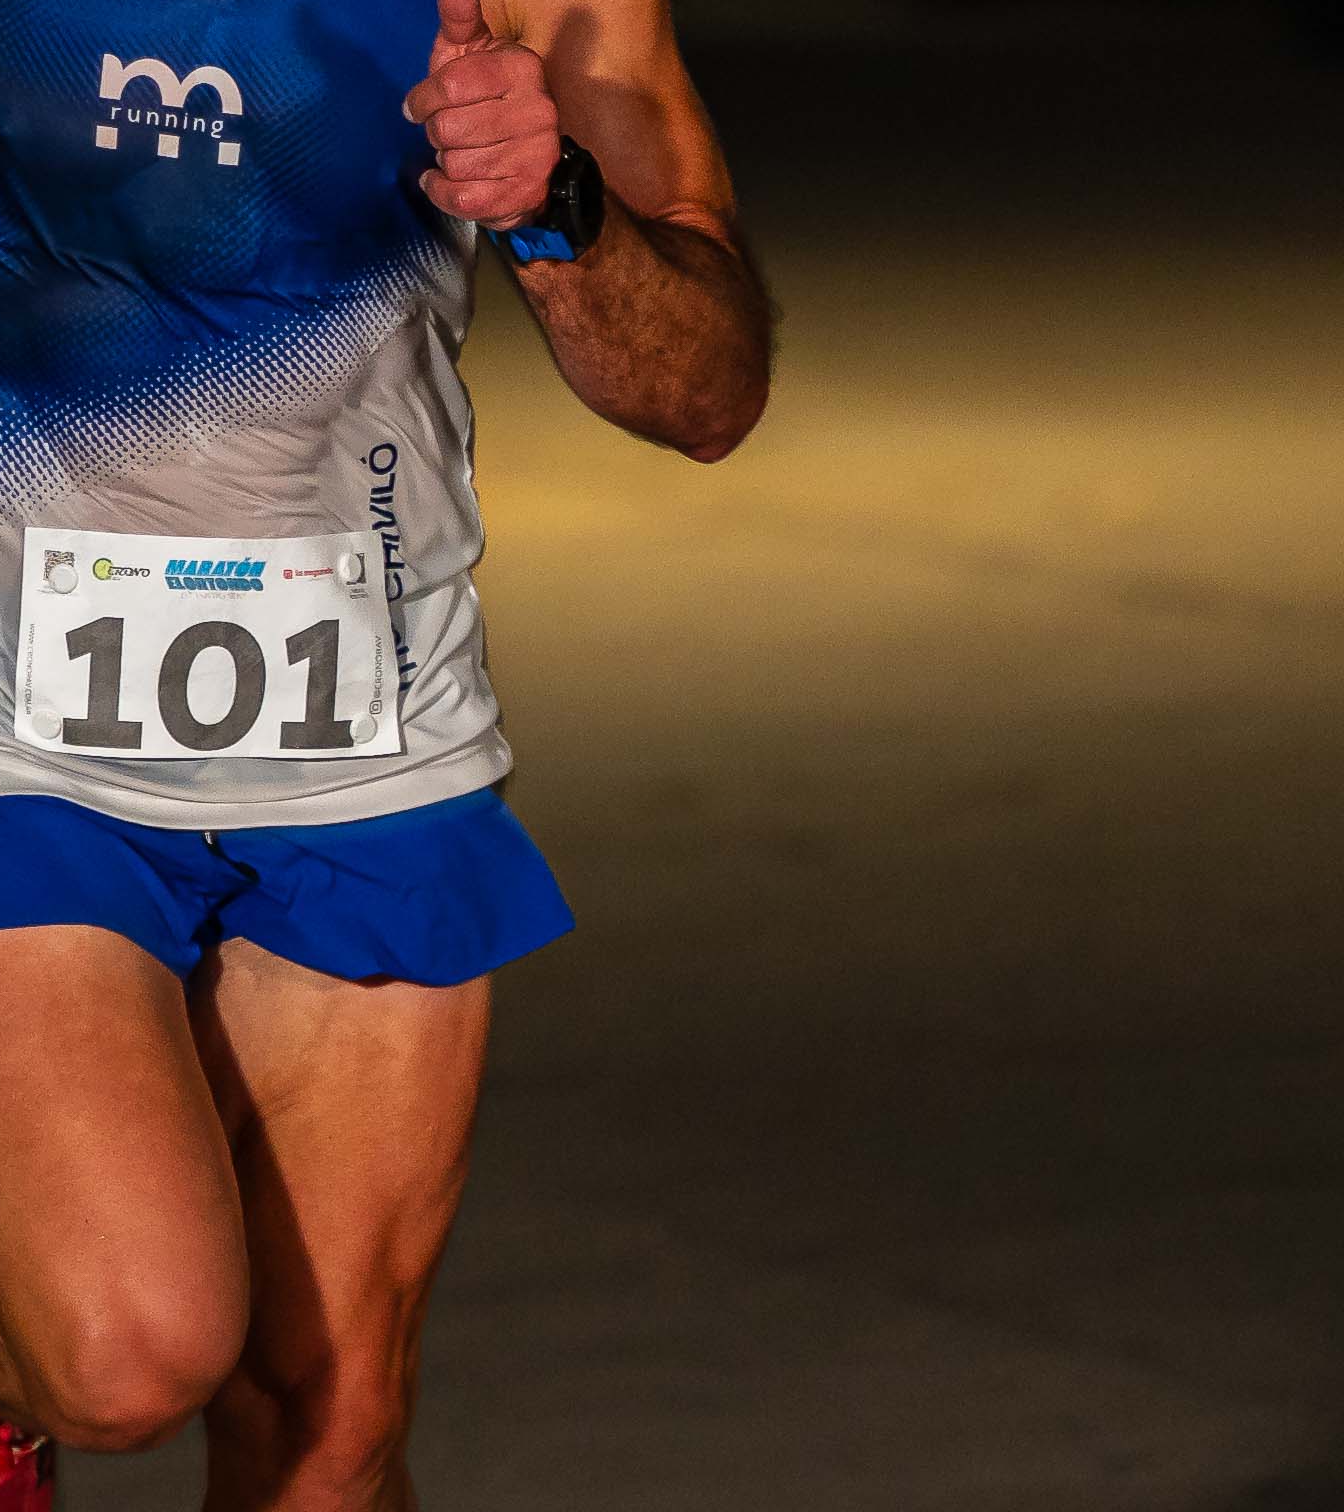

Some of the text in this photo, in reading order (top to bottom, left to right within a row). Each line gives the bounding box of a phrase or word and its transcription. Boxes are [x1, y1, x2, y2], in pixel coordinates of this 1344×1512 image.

[111, 106, 224, 138] running
[165, 557, 266, 577] MARATÓN
[62, 616, 354, 751] 101
